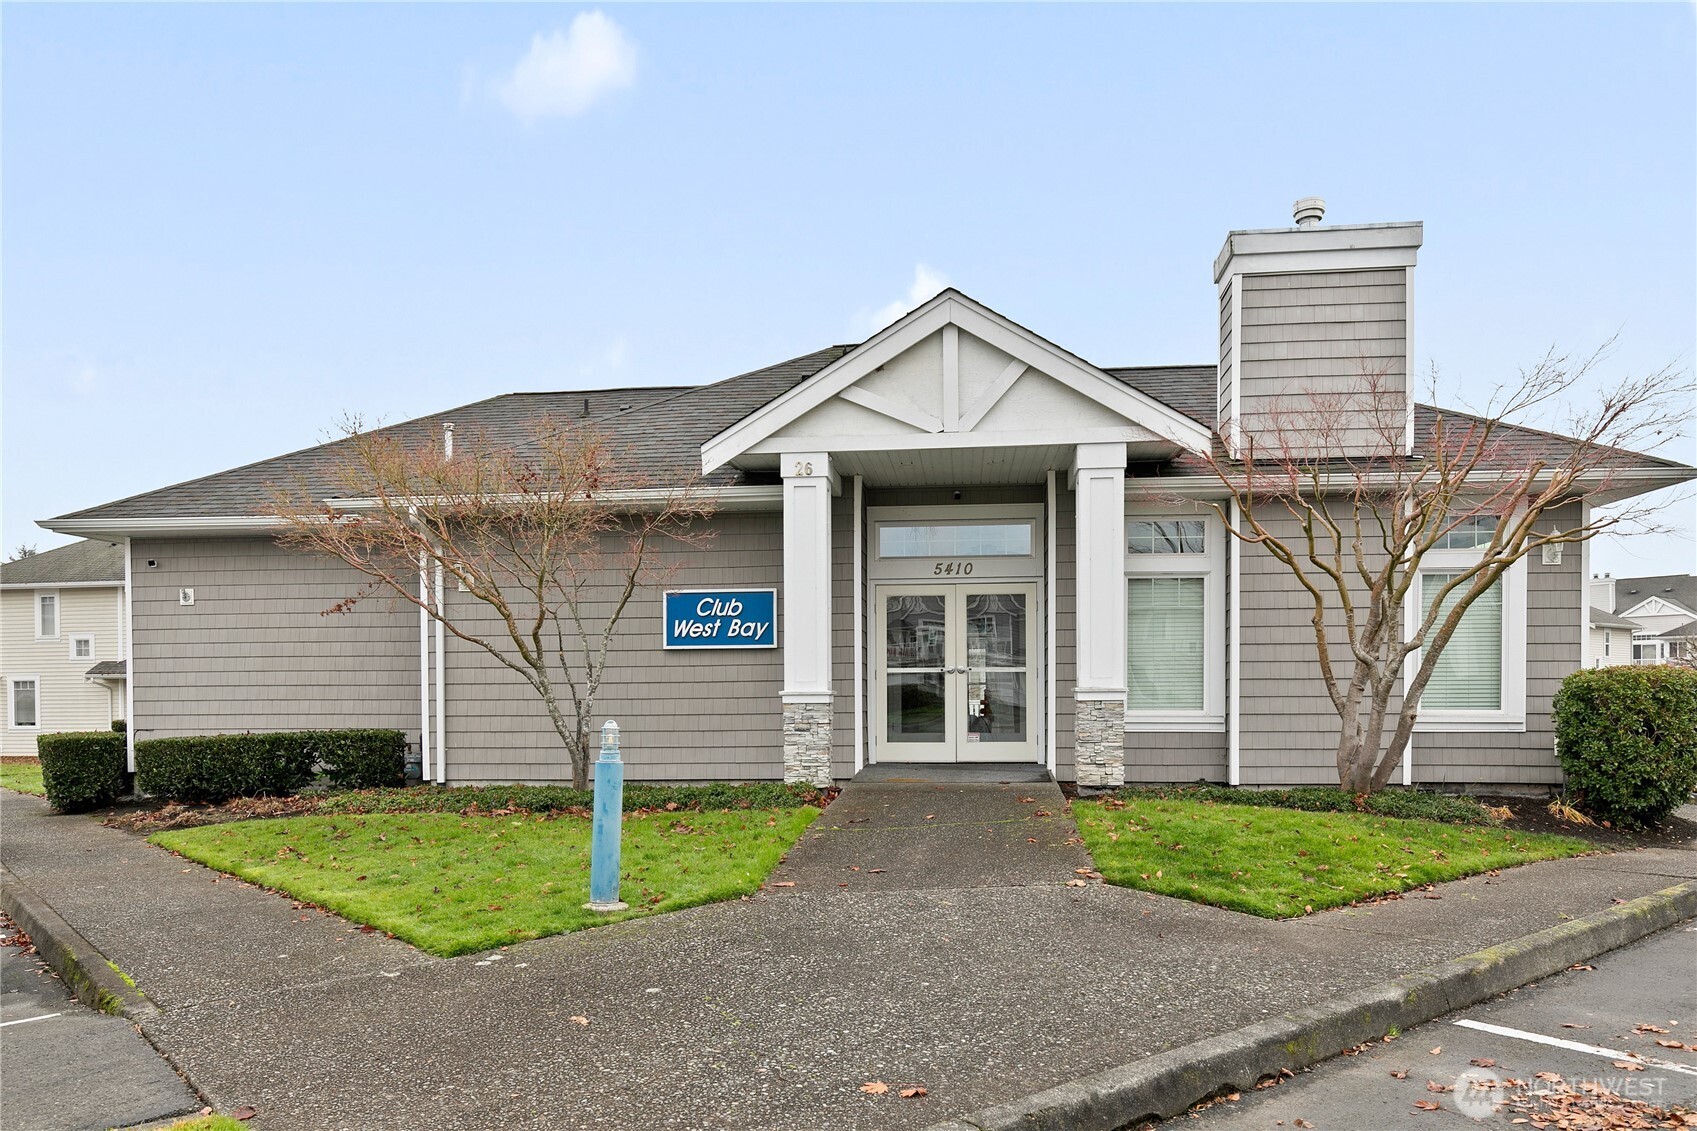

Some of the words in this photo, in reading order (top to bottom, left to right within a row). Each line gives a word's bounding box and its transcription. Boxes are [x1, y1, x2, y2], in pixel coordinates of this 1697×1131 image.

[794, 461, 814, 476] 26
[933, 561, 973, 575] 5410
[696, 597, 743, 617] Club
[674, 619, 722, 637] West
[727, 619, 769, 640] Bay
